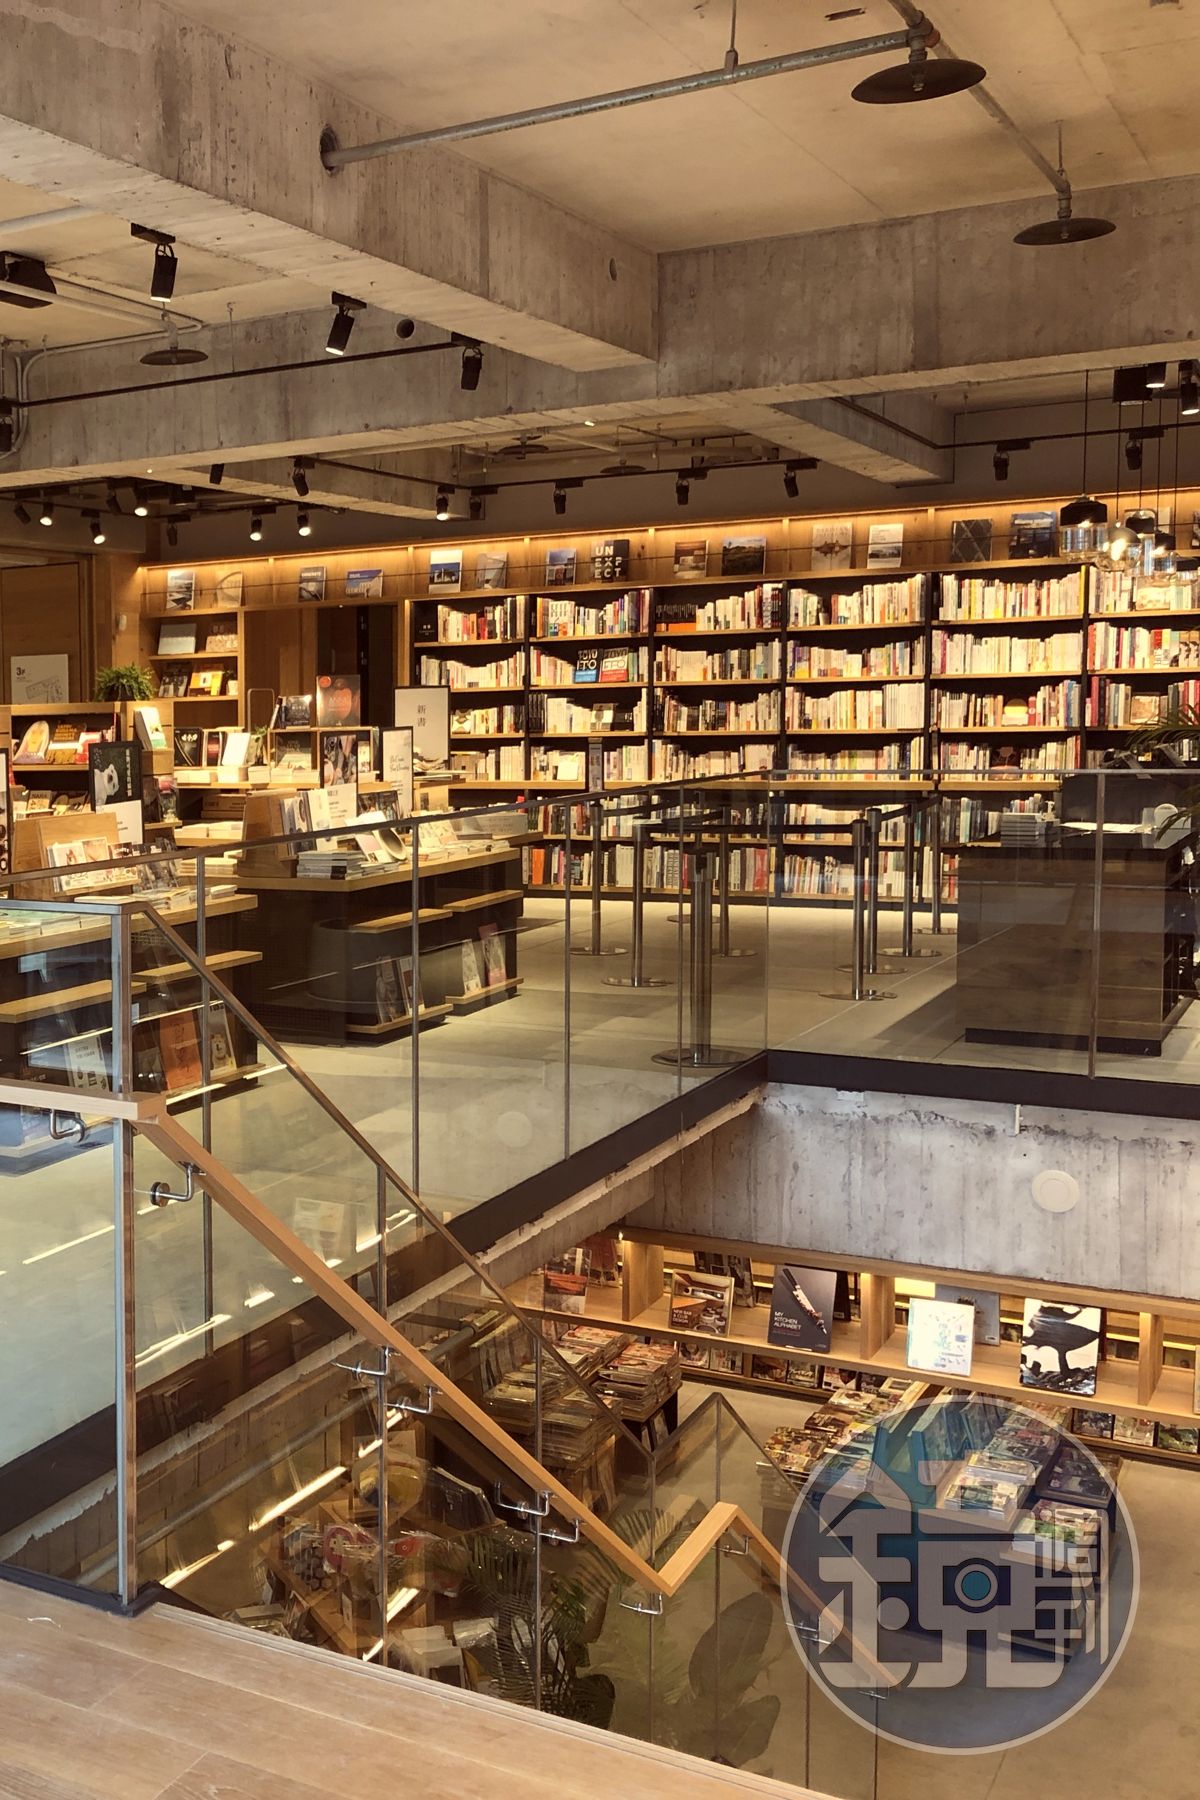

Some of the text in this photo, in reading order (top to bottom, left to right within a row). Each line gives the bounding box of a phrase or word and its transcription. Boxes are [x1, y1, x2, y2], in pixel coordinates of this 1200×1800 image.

[595, 546, 614, 556] UN
[595, 568, 622, 579] ECT
[775, 1317, 798, 1325] KITCHEN
[773, 1322, 802, 1331] ALPHABET
